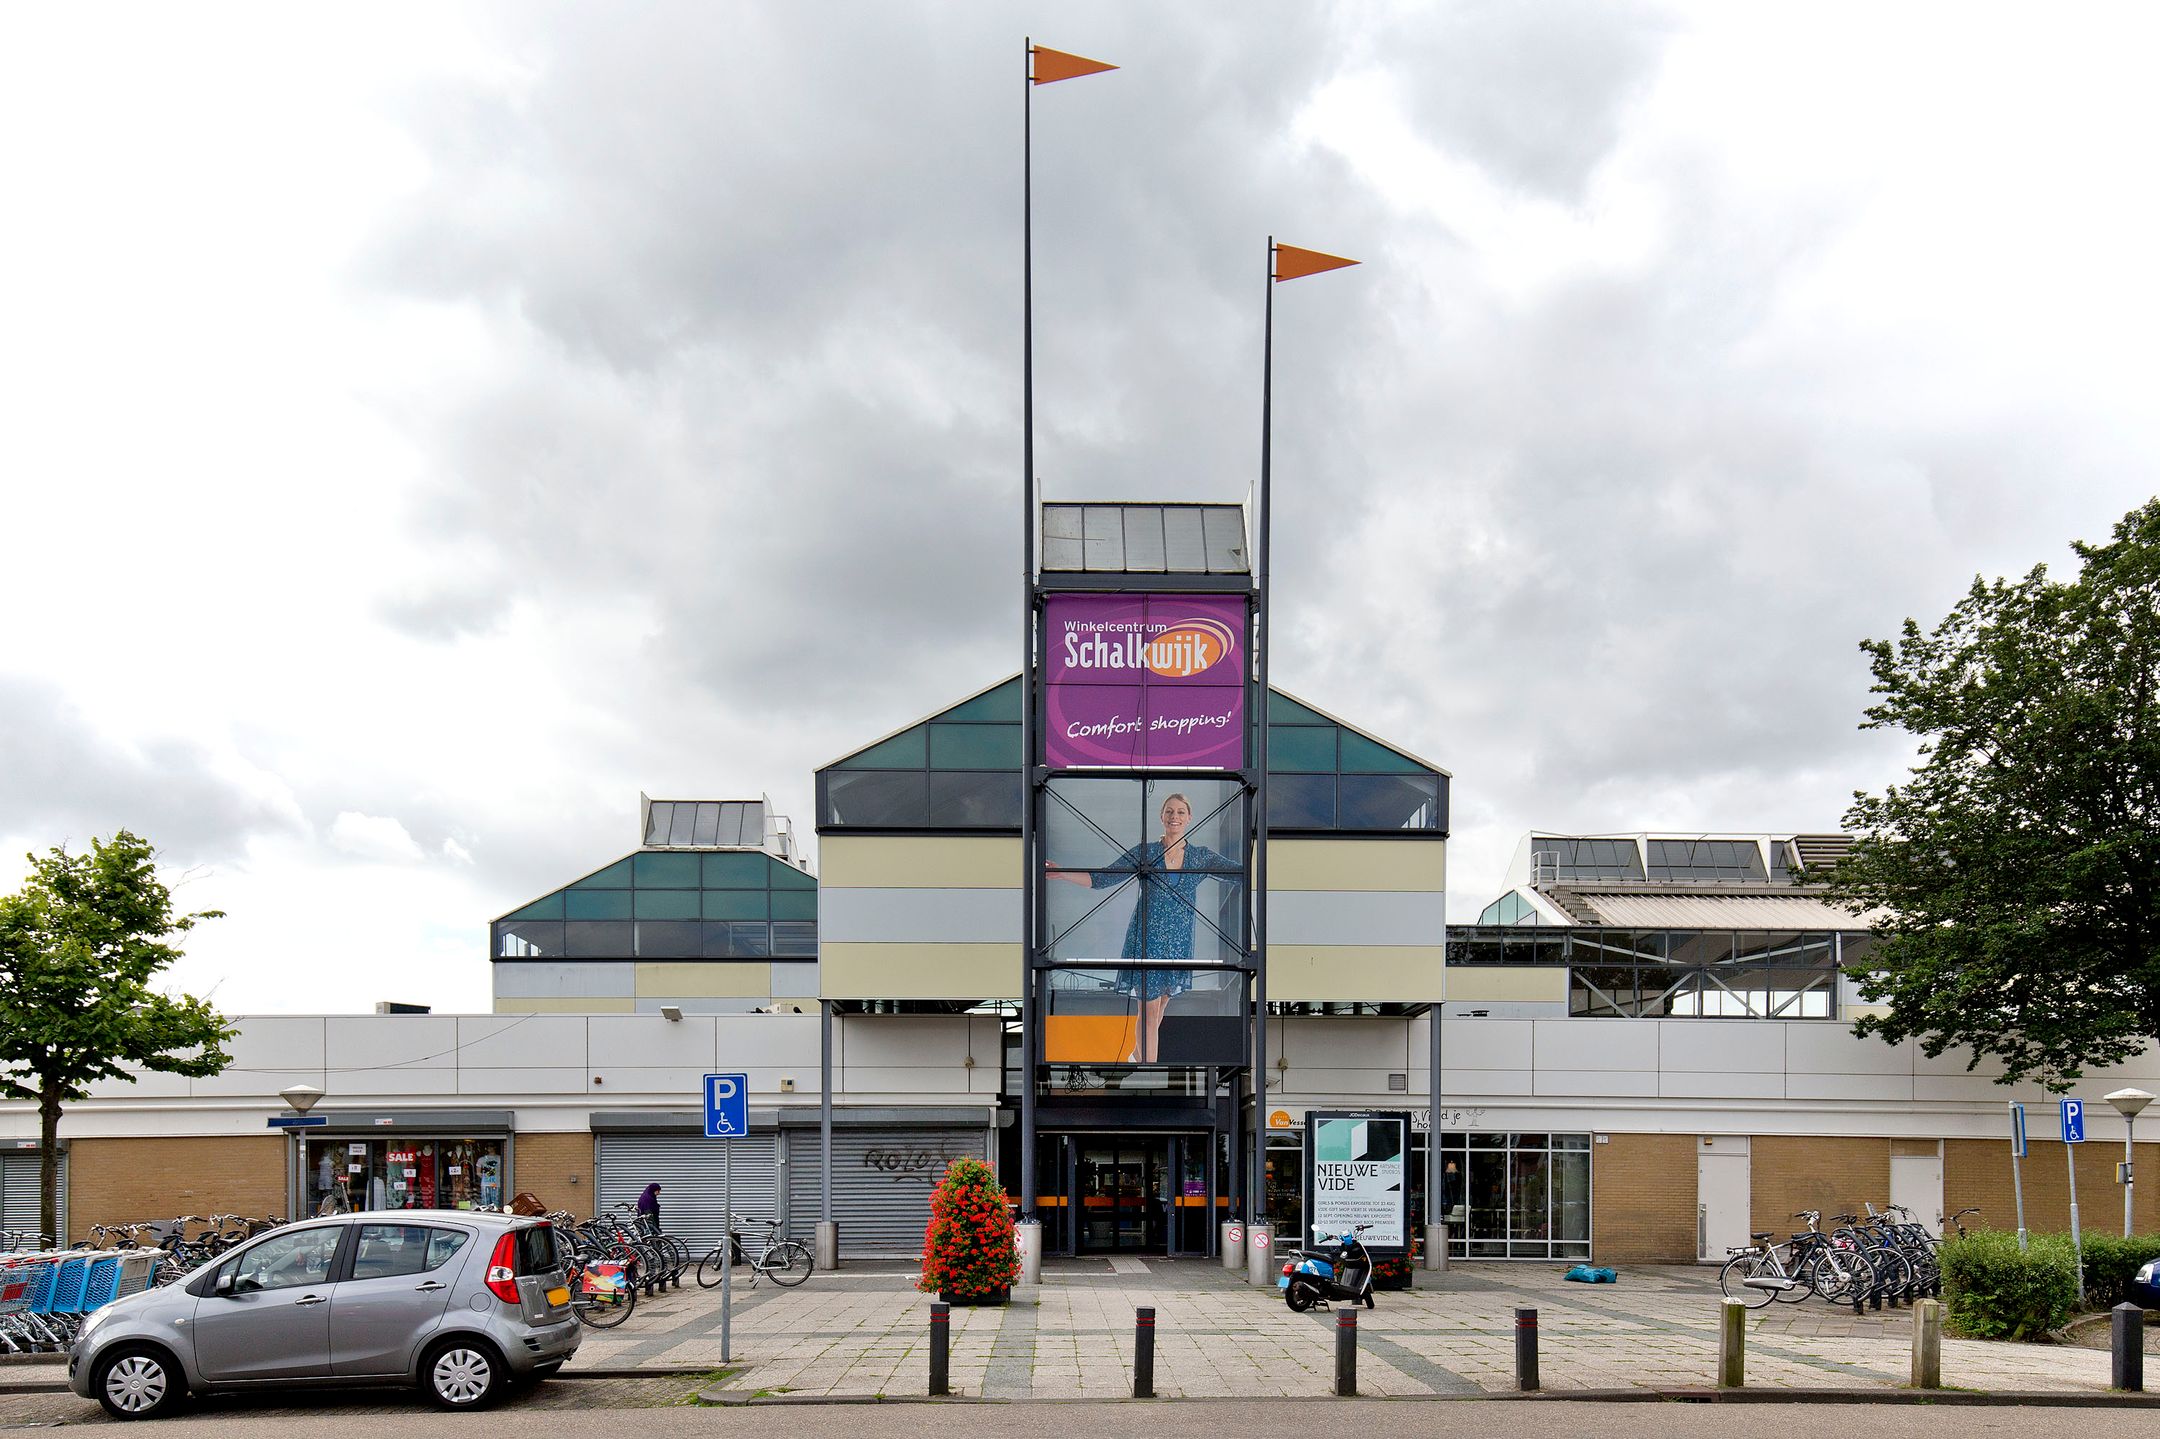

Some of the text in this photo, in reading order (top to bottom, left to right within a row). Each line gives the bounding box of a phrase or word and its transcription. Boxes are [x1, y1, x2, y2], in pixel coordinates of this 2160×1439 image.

[1064, 620, 1167, 633] Winkelcentrum
[1064, 632, 1208, 676] Schalkwijk
[1066, 711, 1232, 738] Comfort shopping!
[714, 1079, 737, 1110] P
[1421, 1109, 1449, 1121] Vid
[2066, 1103, 2079, 1124] P
[388, 1153, 414, 1162] SALE
[1317, 1163, 1379, 1177] NIEUWE
[1318, 1178, 1355, 1191] VIDE
